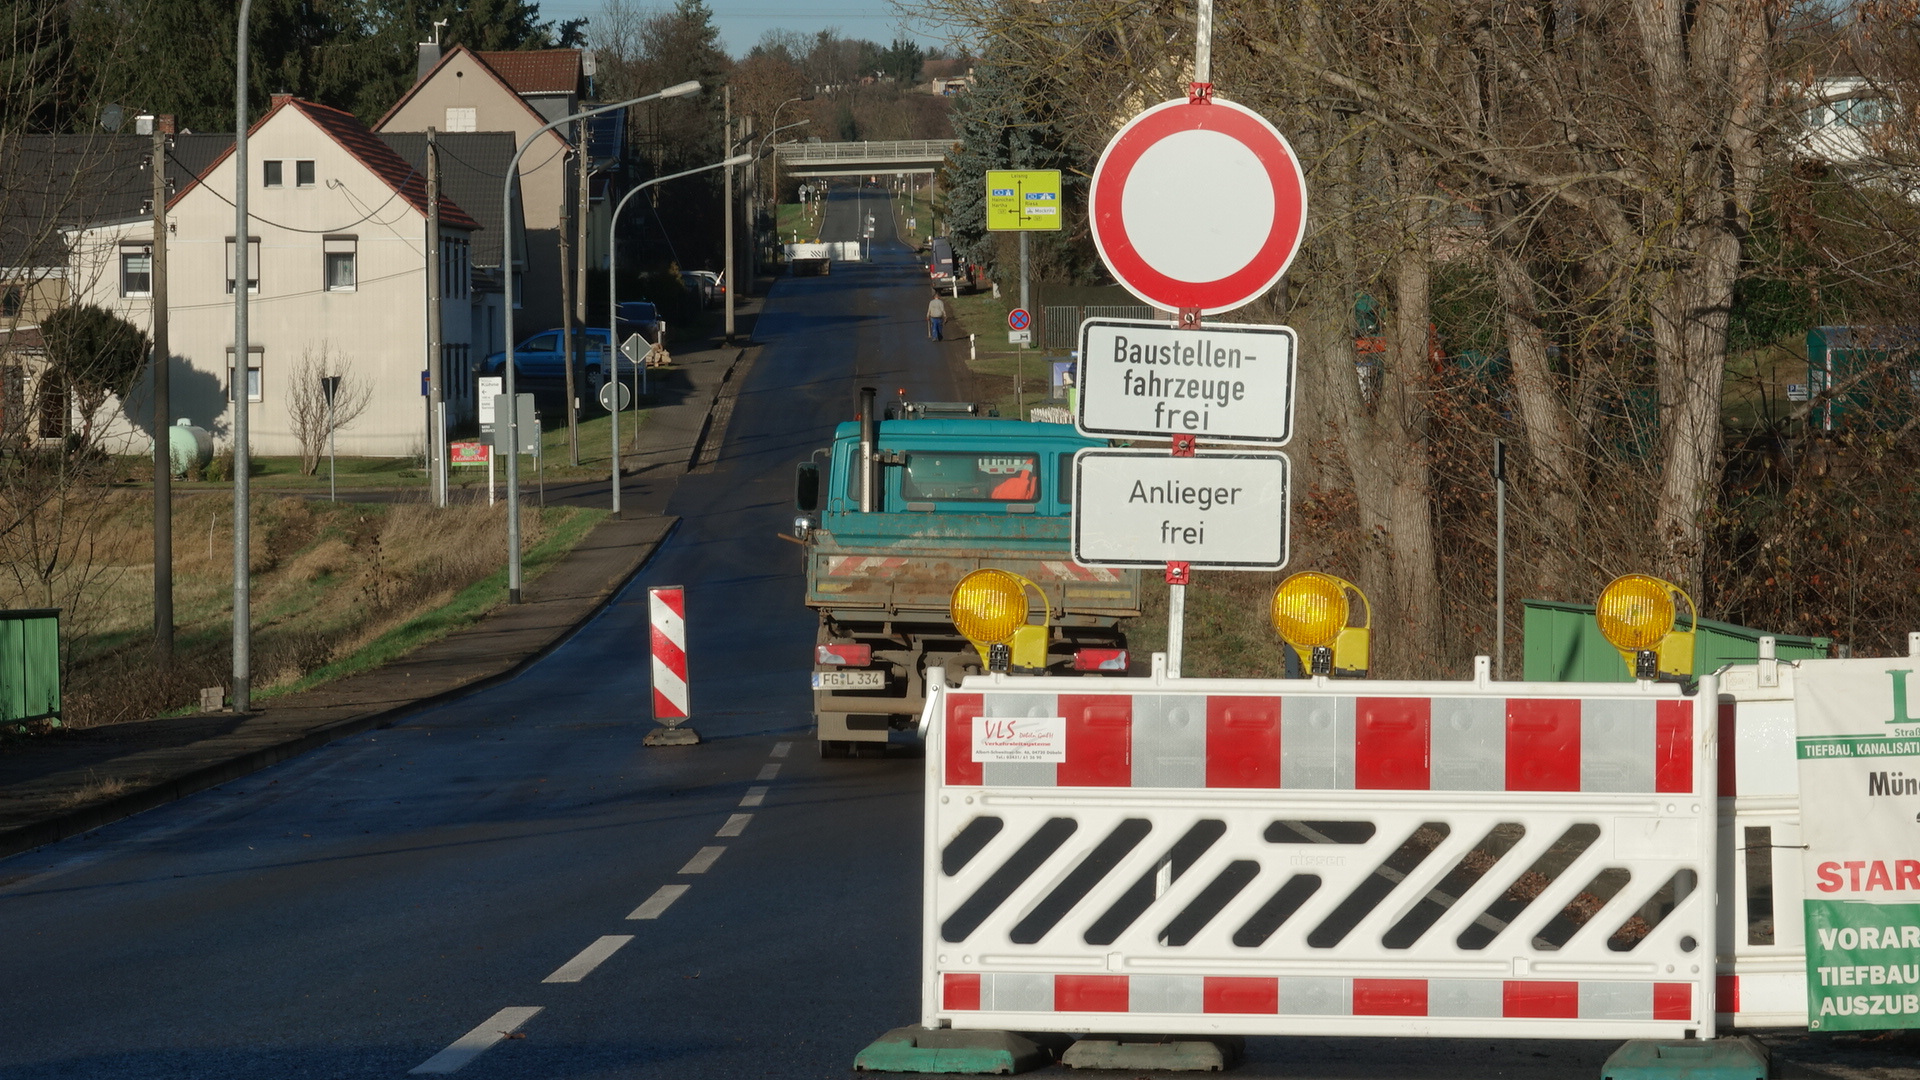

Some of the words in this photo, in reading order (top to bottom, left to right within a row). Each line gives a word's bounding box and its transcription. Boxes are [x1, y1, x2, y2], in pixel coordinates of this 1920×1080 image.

[1114, 335, 1257, 369] Baustellen-
[1123, 369, 1245, 408] fahrzeuge
[1154, 402, 1209, 431] frei
[1129, 479, 1243, 511] Anlieger
[1160, 520, 1205, 545] frei
[823, 673, 839, 685] FG
[846, 673, 854, 685] L
[857, 673, 879, 685] 334
[985, 720, 1016, 739] VLS
[1805, 744, 1854, 758] TIEFBAU,
[1856, 742, 1920, 756] KANALISATI
[1816, 860, 1920, 893] STAR
[1818, 926, 1920, 950] VORAR
[1817, 964, 1919, 986] TIEFBAU
[1820, 994, 1919, 1016] AUSZUB
